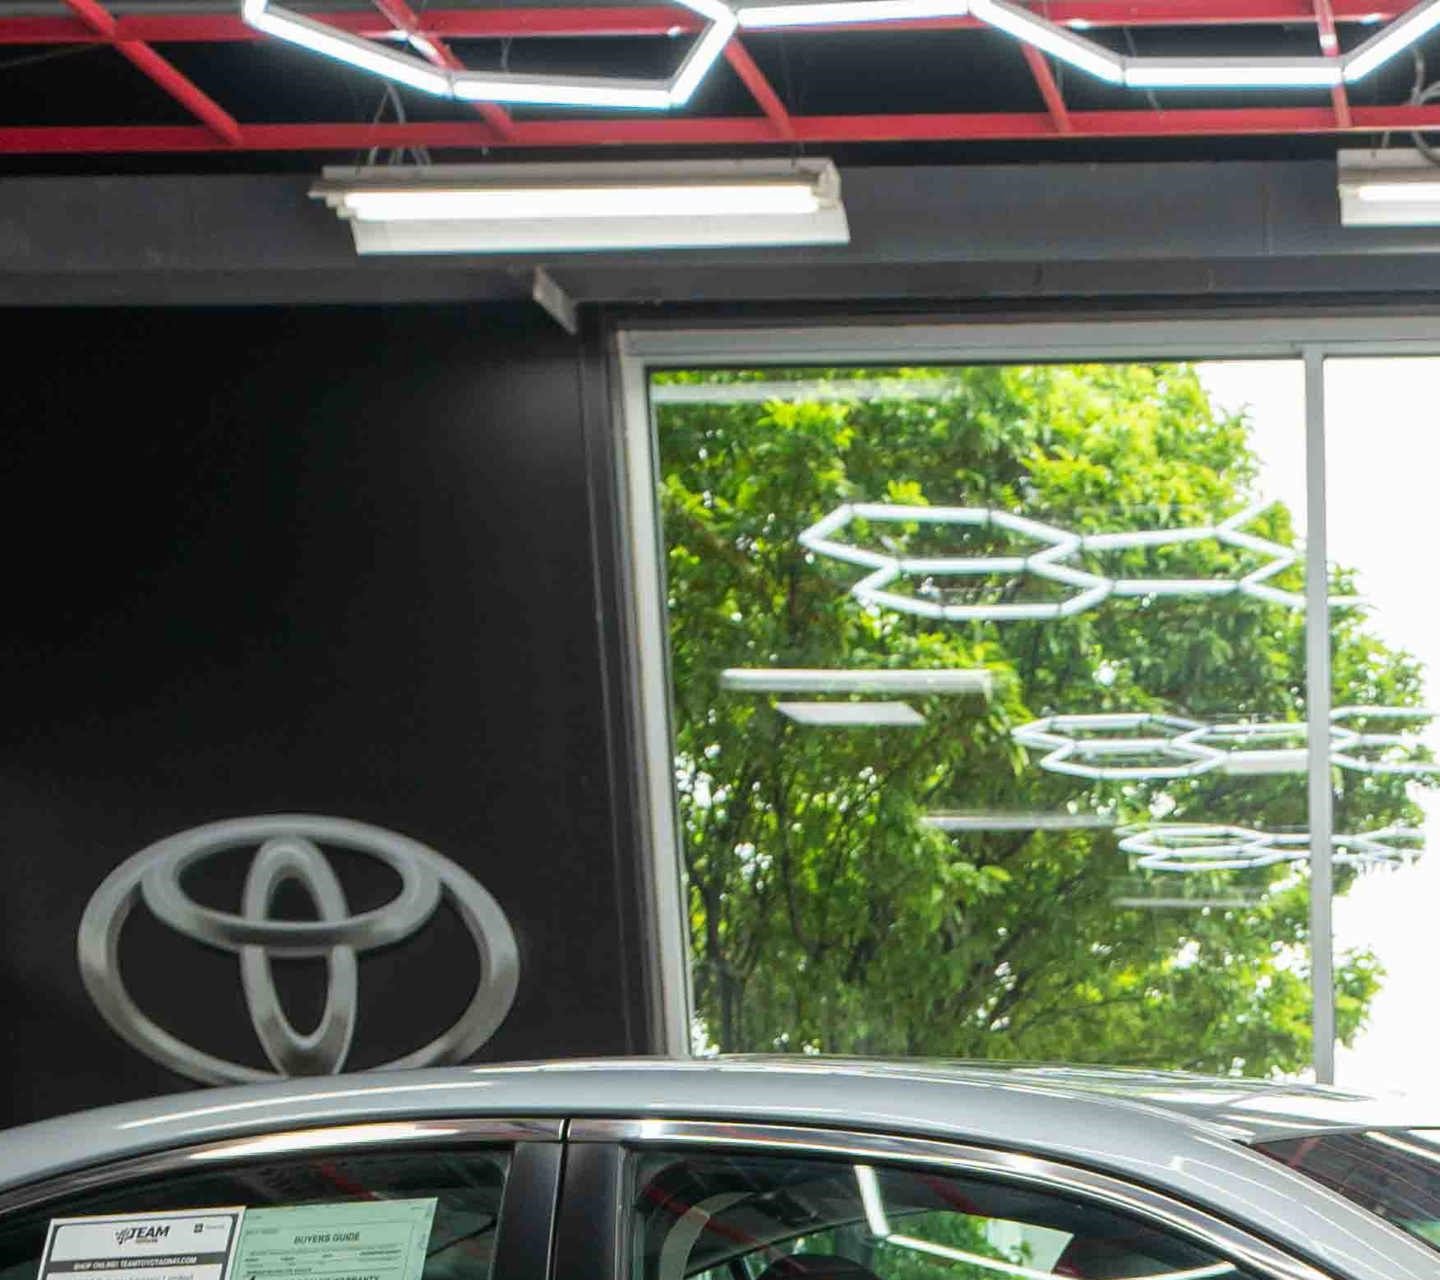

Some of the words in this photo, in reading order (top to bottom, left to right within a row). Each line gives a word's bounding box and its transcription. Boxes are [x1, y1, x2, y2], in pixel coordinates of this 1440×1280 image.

[130, 1225, 170, 1239] TEAM
[293, 1233, 330, 1244] BUYERS
[332, 1231, 360, 1242] GUIDE
[73, 1262, 92, 1271] SHOP
